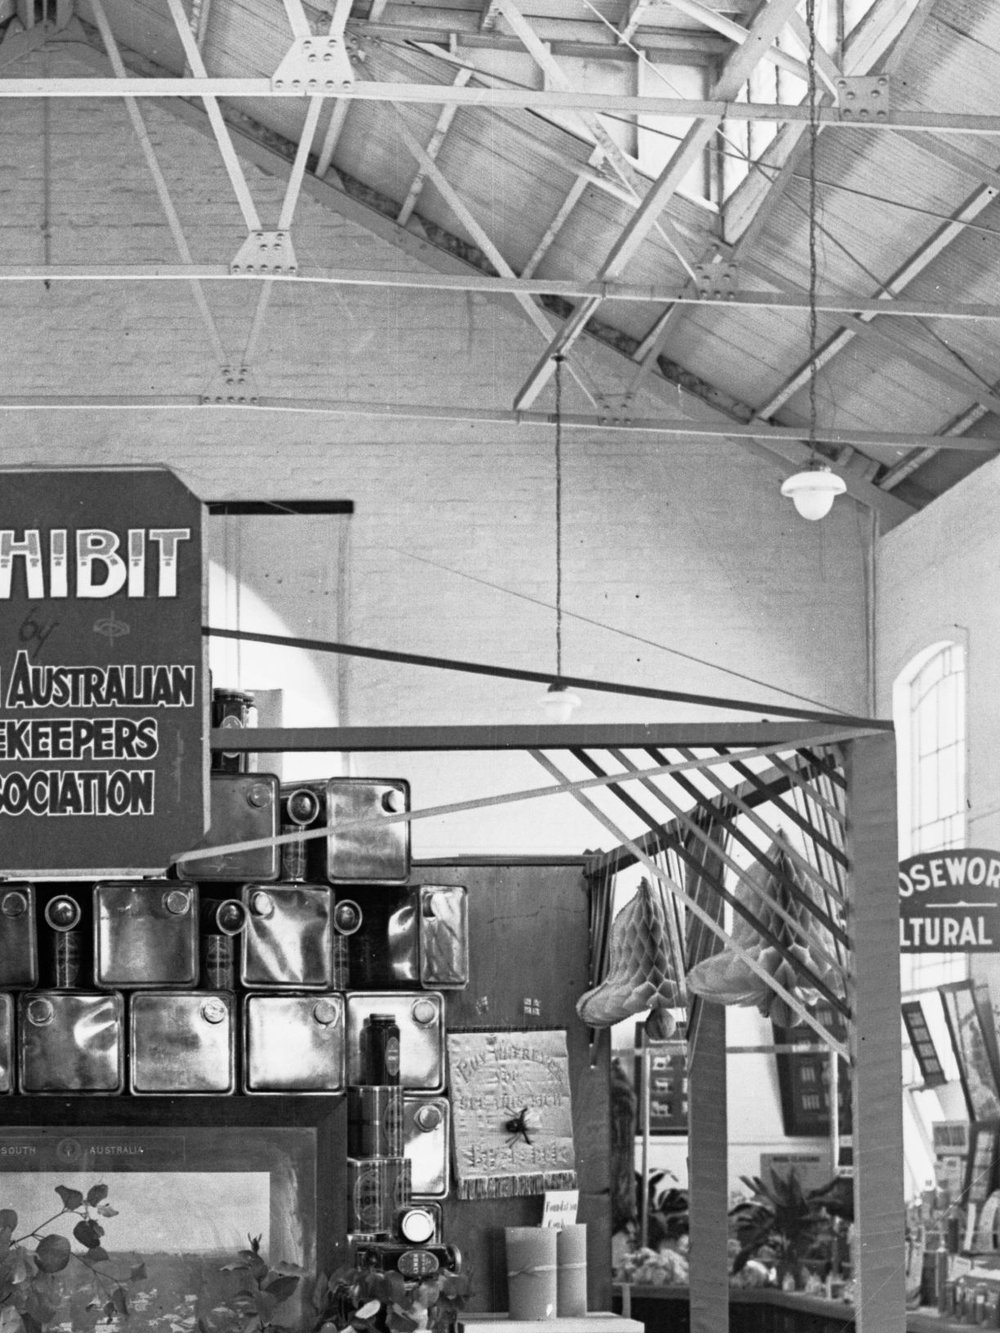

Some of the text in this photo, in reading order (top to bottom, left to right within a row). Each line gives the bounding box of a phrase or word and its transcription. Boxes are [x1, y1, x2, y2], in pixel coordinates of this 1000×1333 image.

[18, 607, 58, 658] by
[6, 650, 195, 708] AUSTRALIAN
[0, 1146, 144, 1155] SOUTH AUSTRALIA
